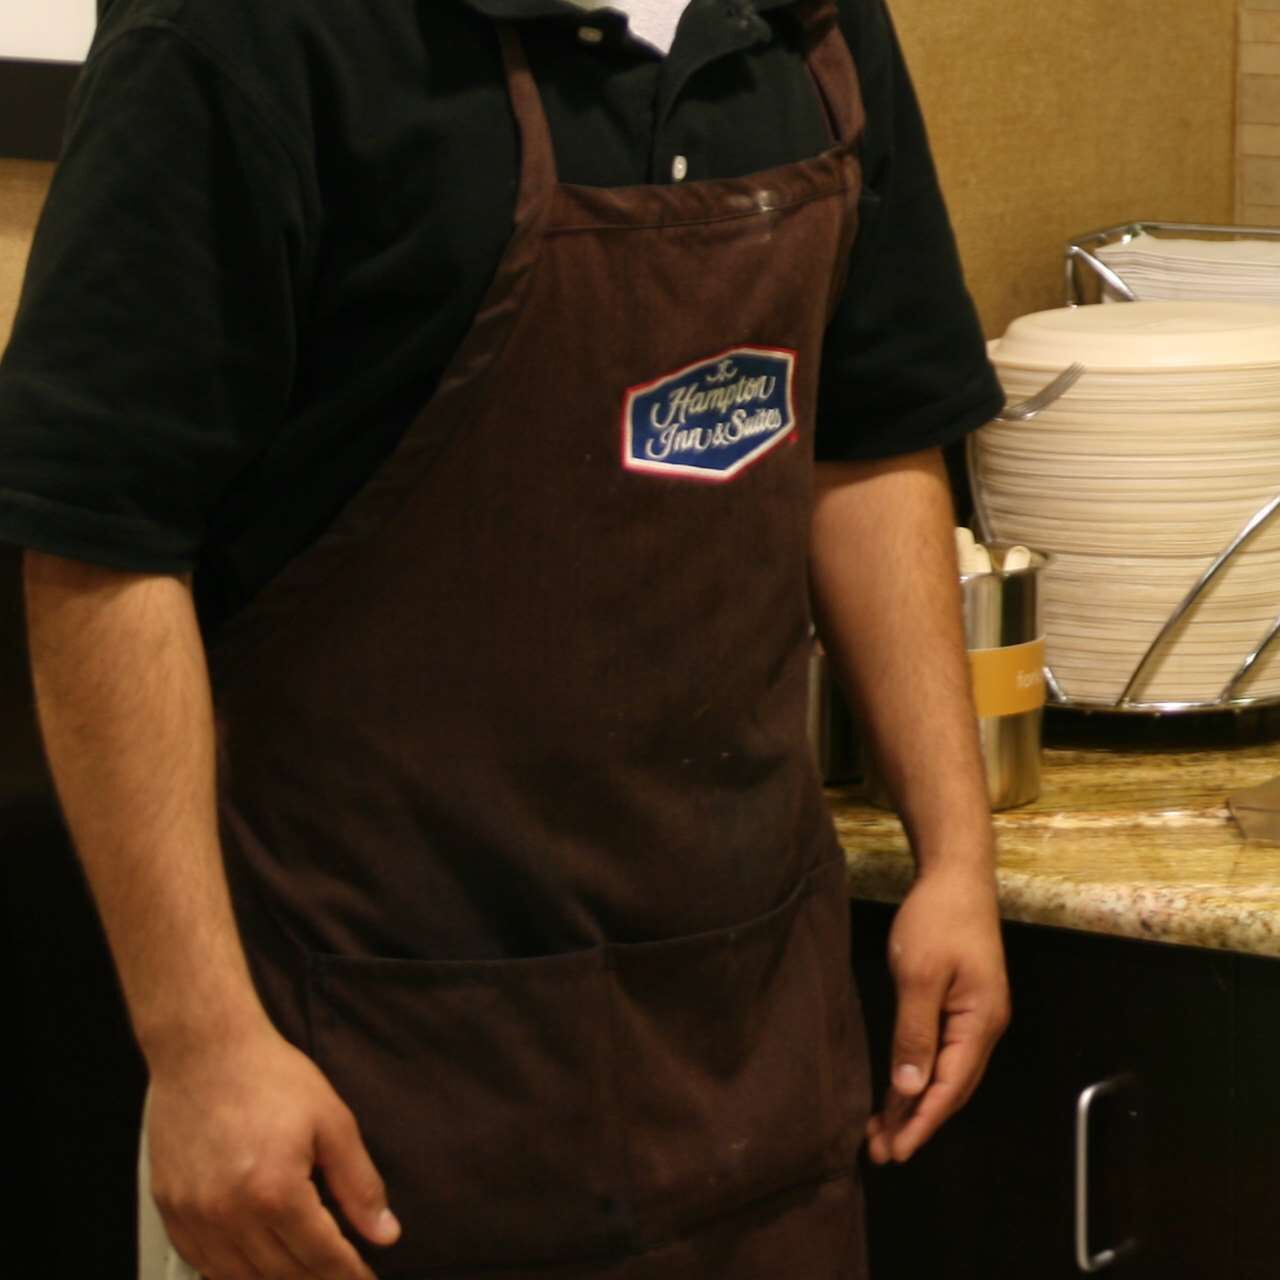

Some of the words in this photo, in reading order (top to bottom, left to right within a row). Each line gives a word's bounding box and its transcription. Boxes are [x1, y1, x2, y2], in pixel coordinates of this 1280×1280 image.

[650, 375, 776, 428] Hampton
[645, 422, 713, 458] Inn
[712, 422, 728, 445] &
[724, 408, 782, 441] Suites
